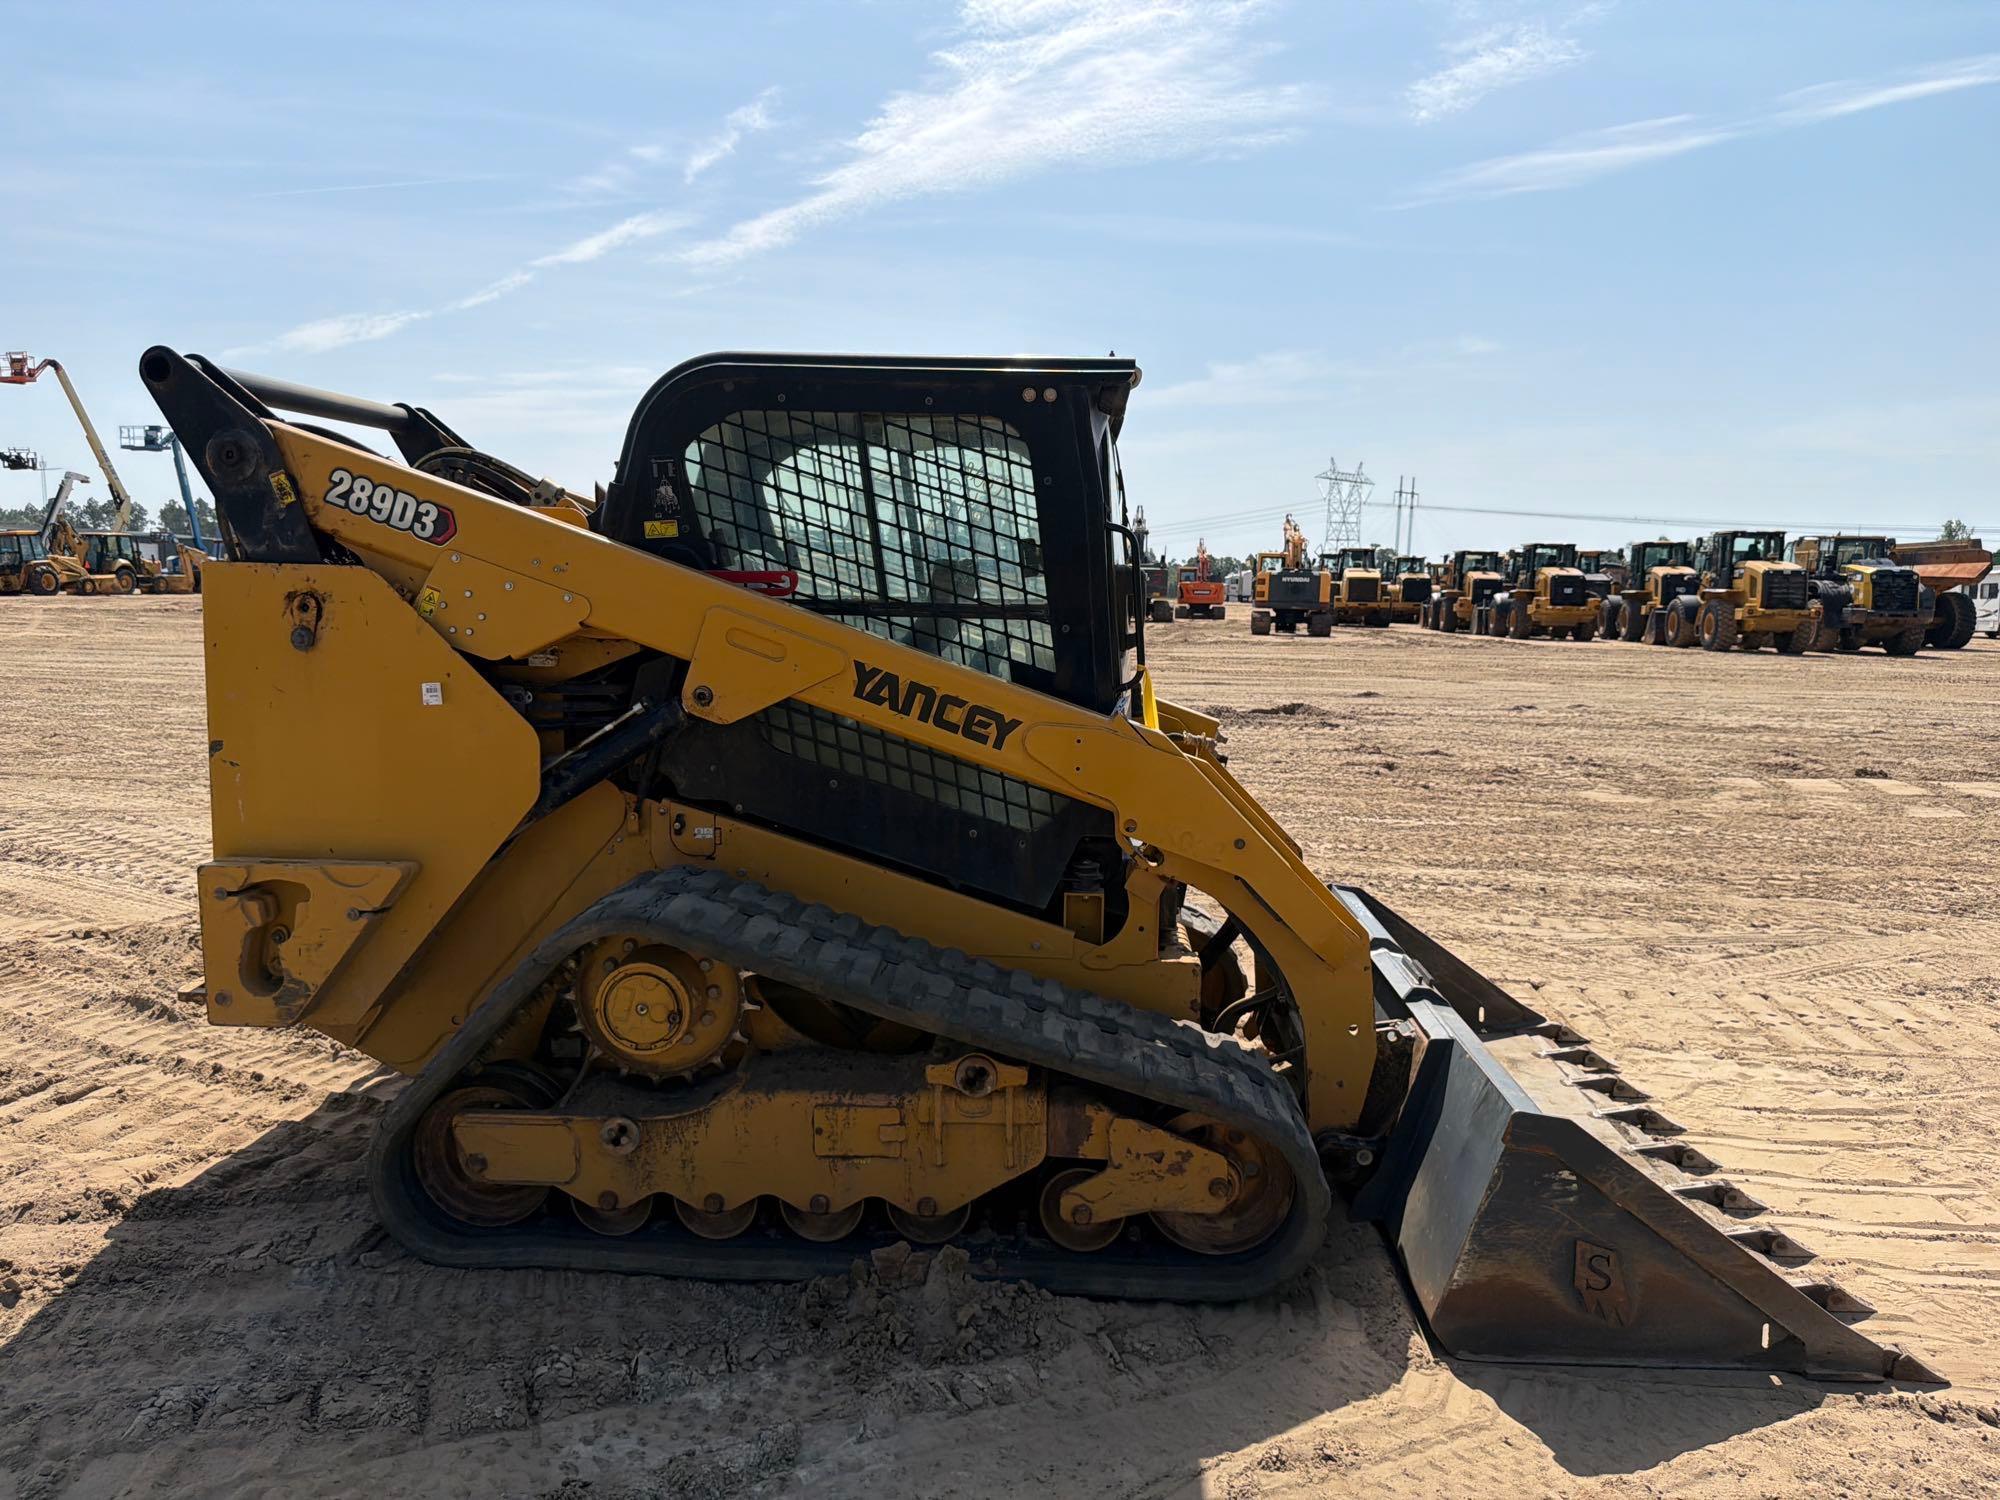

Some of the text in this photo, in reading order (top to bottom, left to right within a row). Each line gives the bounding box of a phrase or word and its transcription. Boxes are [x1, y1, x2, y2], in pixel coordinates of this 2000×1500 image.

[324, 468, 439, 539] 289D3
[853, 659, 1024, 751] YANCEY
[1585, 1254, 1612, 1292] S
